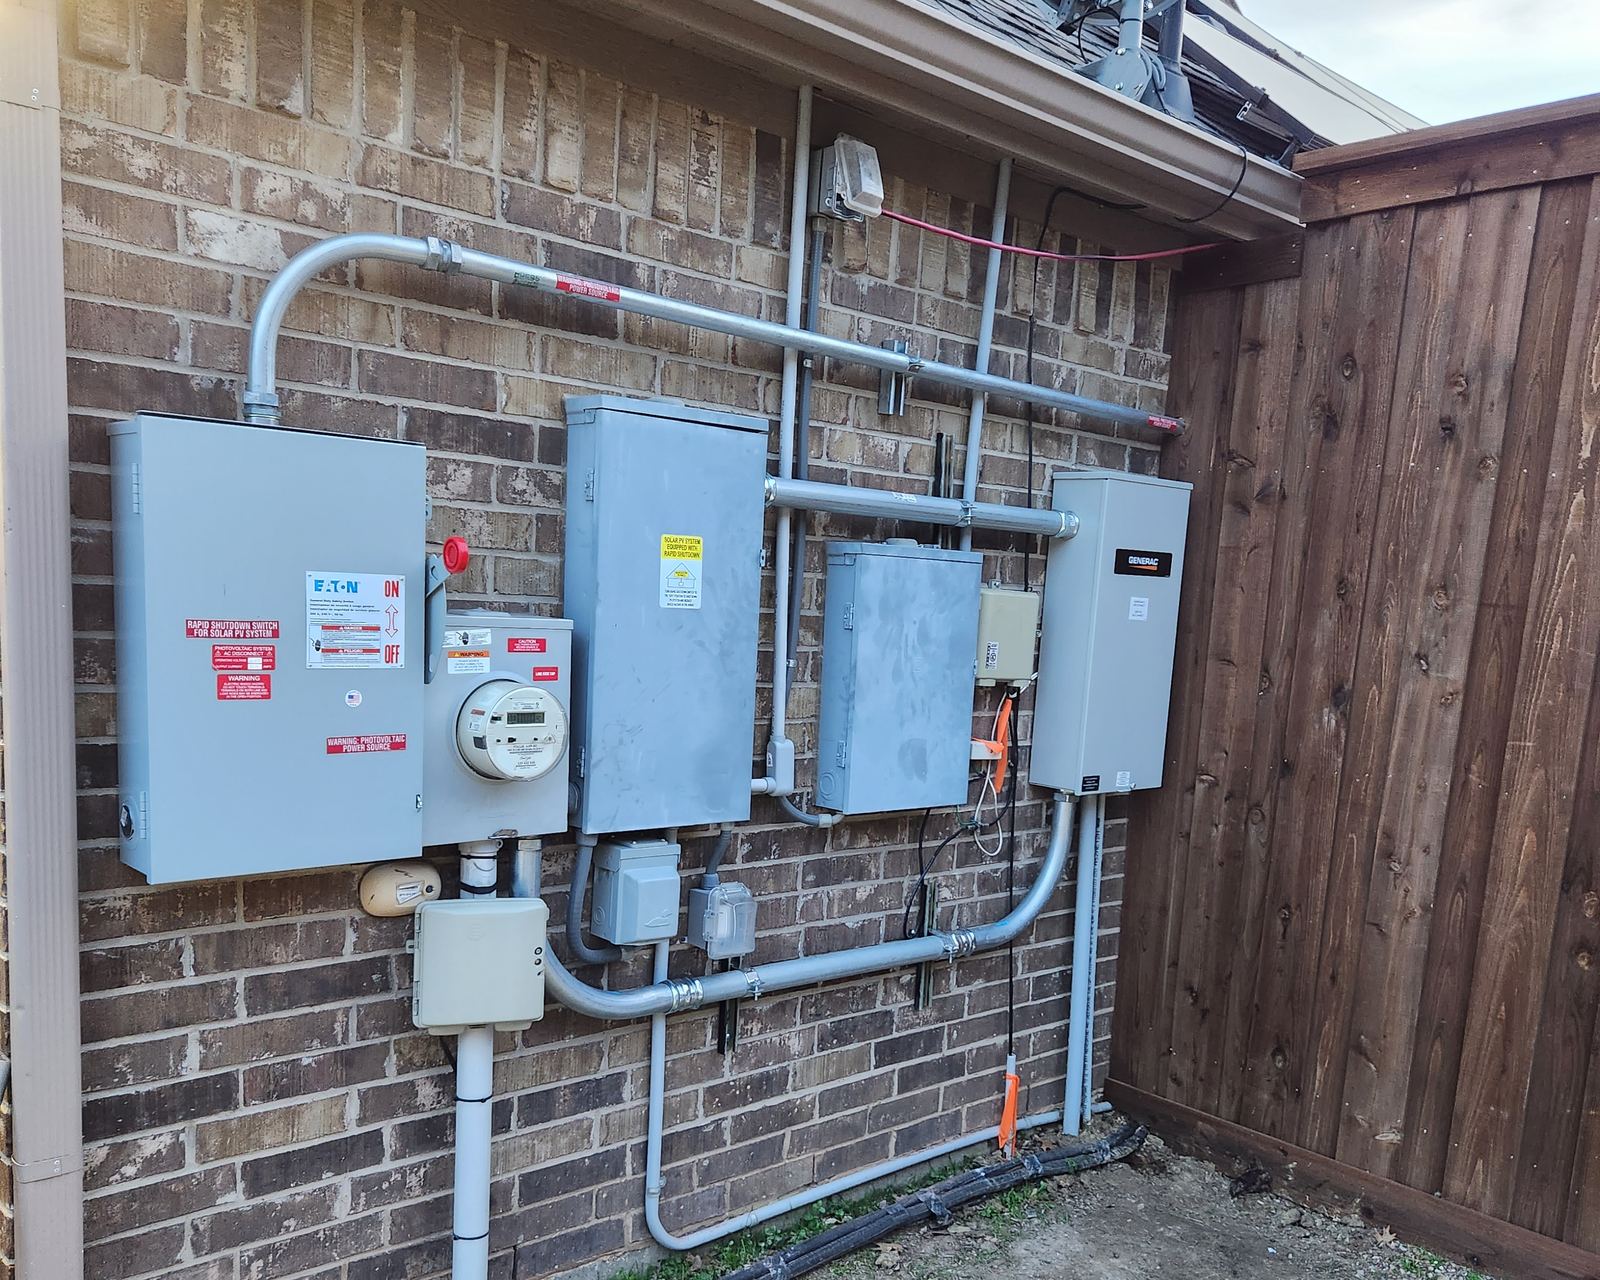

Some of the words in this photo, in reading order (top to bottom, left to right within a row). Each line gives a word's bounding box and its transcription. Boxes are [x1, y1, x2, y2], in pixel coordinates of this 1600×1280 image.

[570, 284, 588, 295] POWER
[588, 288, 608, 299] SOURCE
[1128, 556, 1159, 565] GENERAC
[384, 580, 399, 597] ON
[384, 644, 400, 663] OFF
[328, 737, 359, 746] WARNING:
[360, 735, 405, 744] PHOTOVOLTAIC
[367, 743, 390, 751] SOURCE
